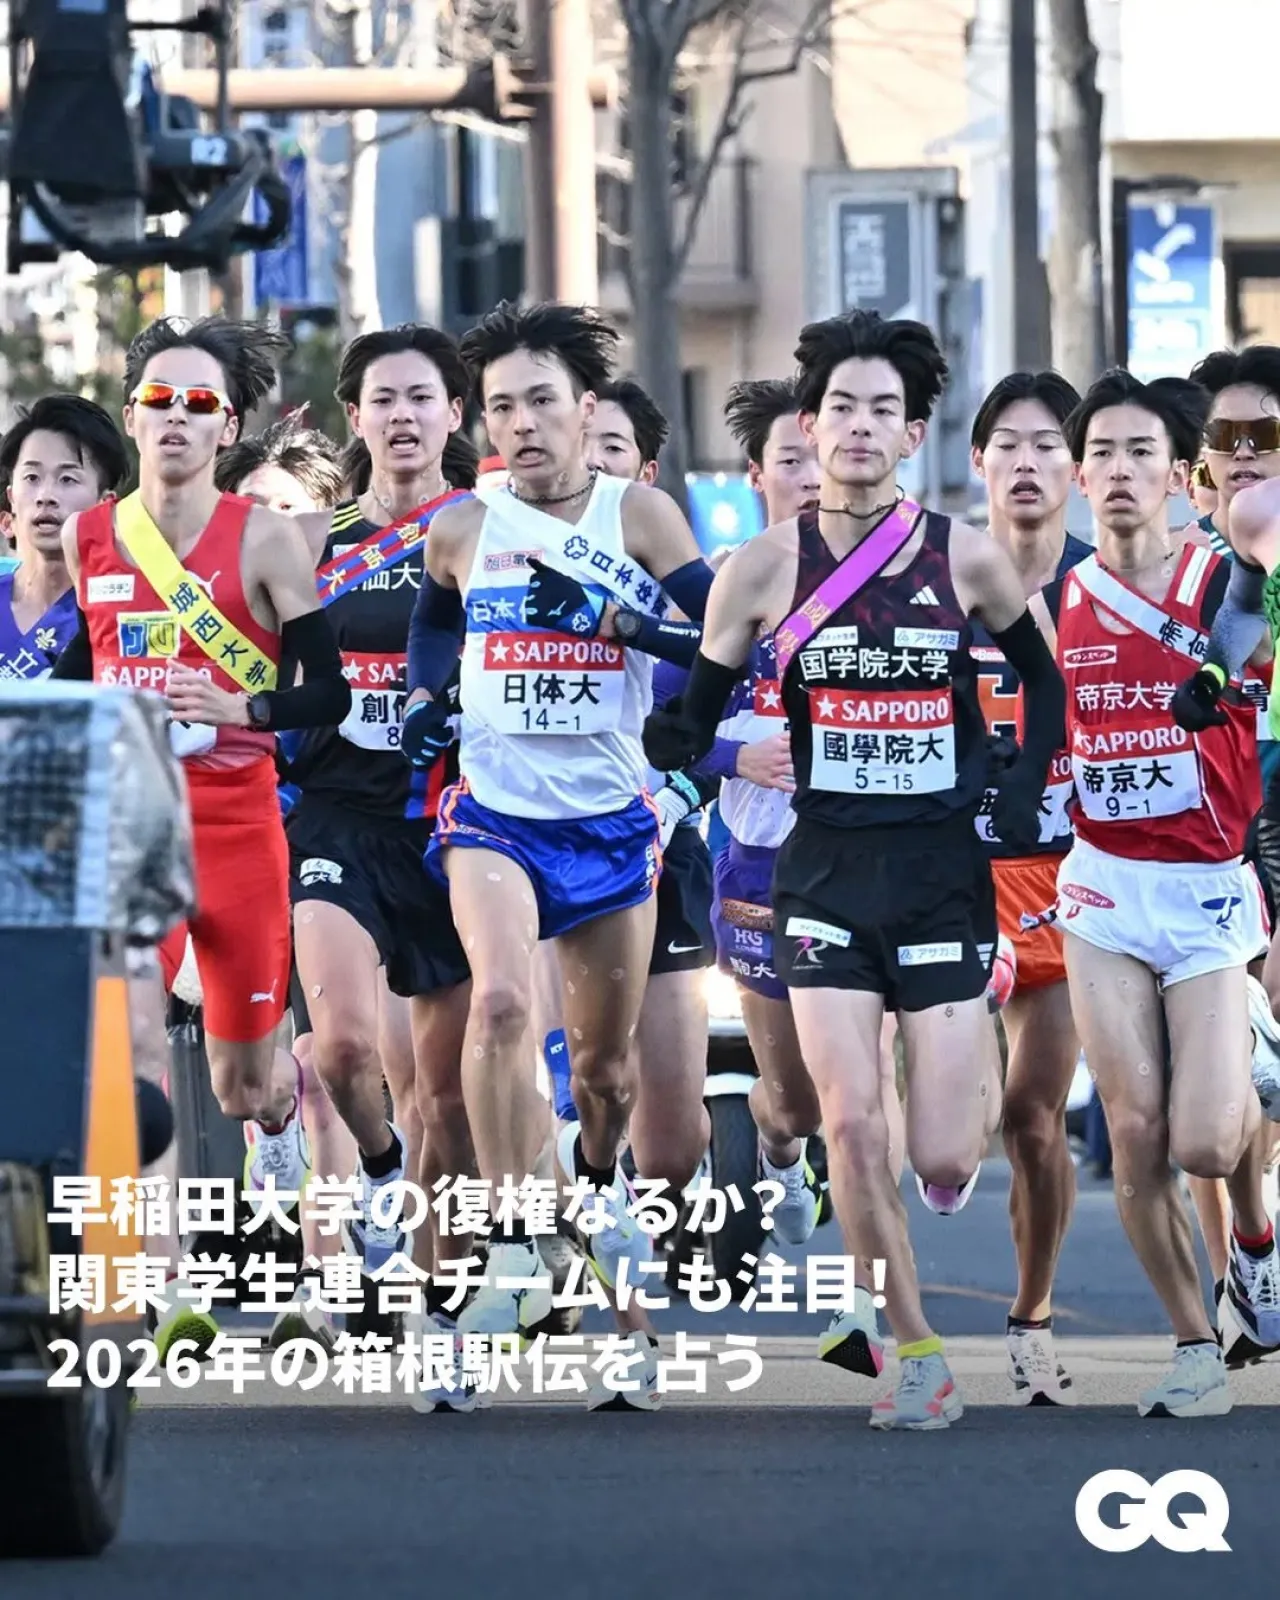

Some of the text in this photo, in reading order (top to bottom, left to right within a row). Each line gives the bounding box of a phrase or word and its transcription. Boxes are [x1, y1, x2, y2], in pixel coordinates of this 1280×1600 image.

[169, 582, 268, 686] 城西大学
[512, 641, 620, 663] SAPPORO
[799, 647, 950, 680] 国学院大学
[504, 673, 601, 705] 日体大
[1075, 681, 1177, 711] 帝京大学
[522, 707, 581, 731] 14-1
[841, 697, 949, 723] SAPPORO
[823, 730, 945, 764] 國學院大
[1082, 724, 1187, 756] SAPPORO
[855, 767, 914, 790] 5-15
[1082, 759, 1174, 794] 帝京大
[1105, 796, 1151, 817] 9-1
